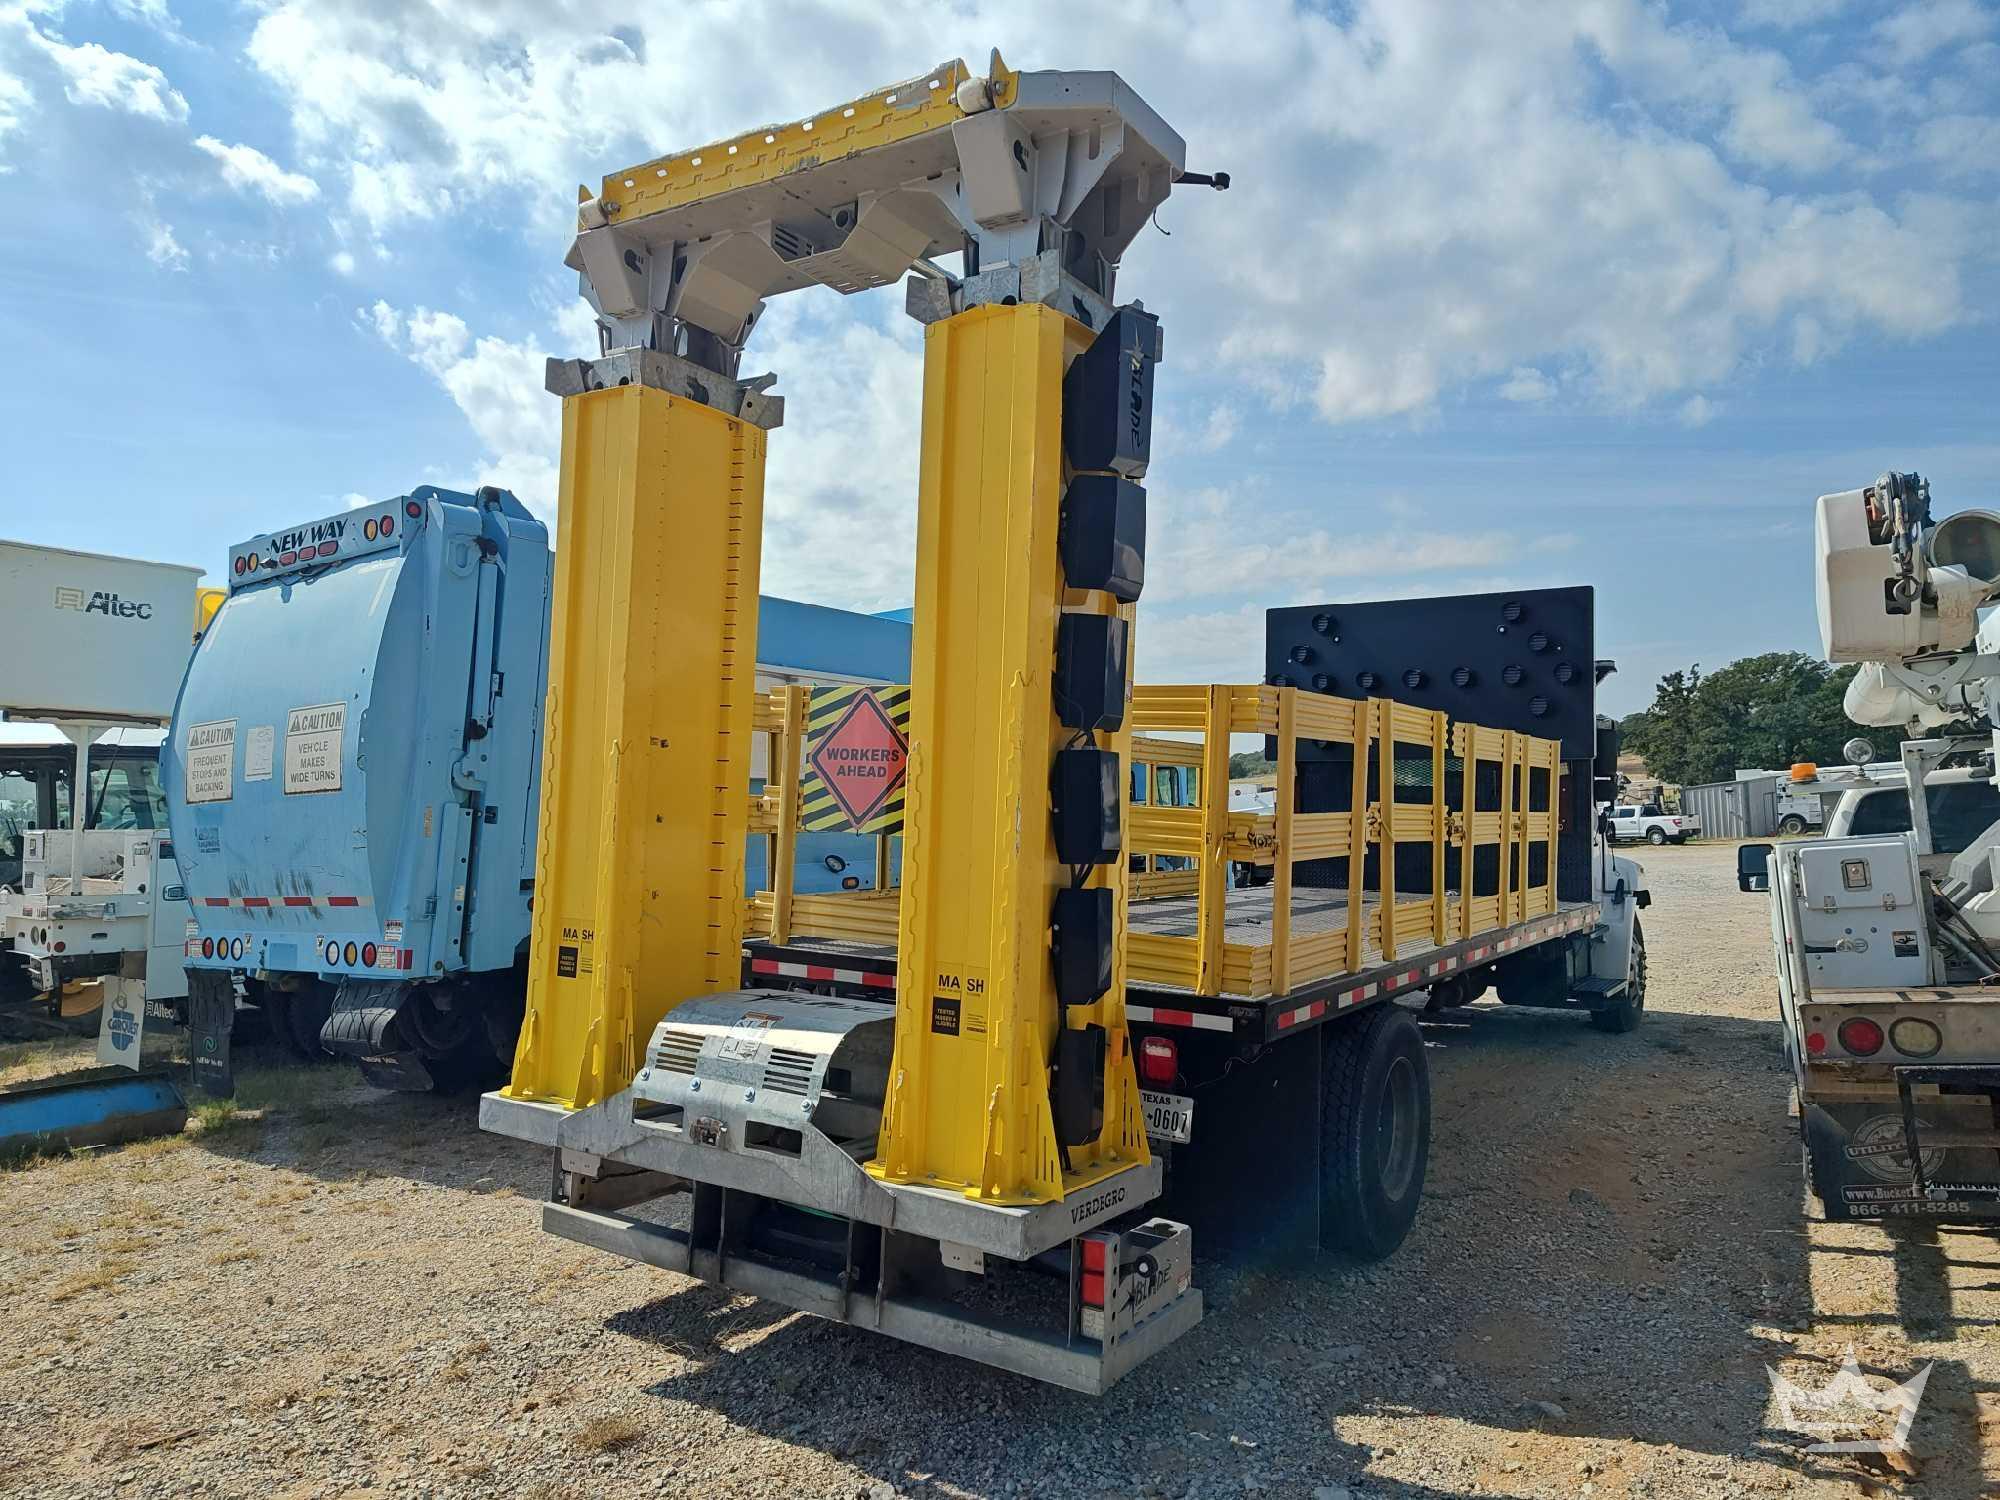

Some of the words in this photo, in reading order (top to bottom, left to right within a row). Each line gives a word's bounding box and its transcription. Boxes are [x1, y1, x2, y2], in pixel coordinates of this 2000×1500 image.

[270, 528, 308, 553] NEW
[311, 518, 348, 542] WAY
[85, 591, 152, 620] Altec
[301, 710, 343, 730] CAUTION
[200, 727, 234, 745] CAUTION
[299, 741, 328, 754] VEHICLE
[193, 754, 226, 767] FREQUENT
[827, 748, 900, 762] WORKERS
[300, 756, 325, 769] MAKES
[192, 770, 212, 780] STOPS
[214, 768, 227, 777] AND
[291, 773, 309, 783] WIDE
[311, 770, 335, 782] TURNS
[836, 765, 887, 778] AHEAD
[195, 783, 224, 793] BACKING
[153, 1002, 175, 1019] Altec
[1142, 1093, 1171, 1105] TEXAS
[1153, 1108, 1188, 1134] 0607
[1071, 1187, 1126, 1224] VERDEGRO
[1850, 1204, 1886, 1215] 866-
[1891, 1202, 1970, 1214] 411-5285
